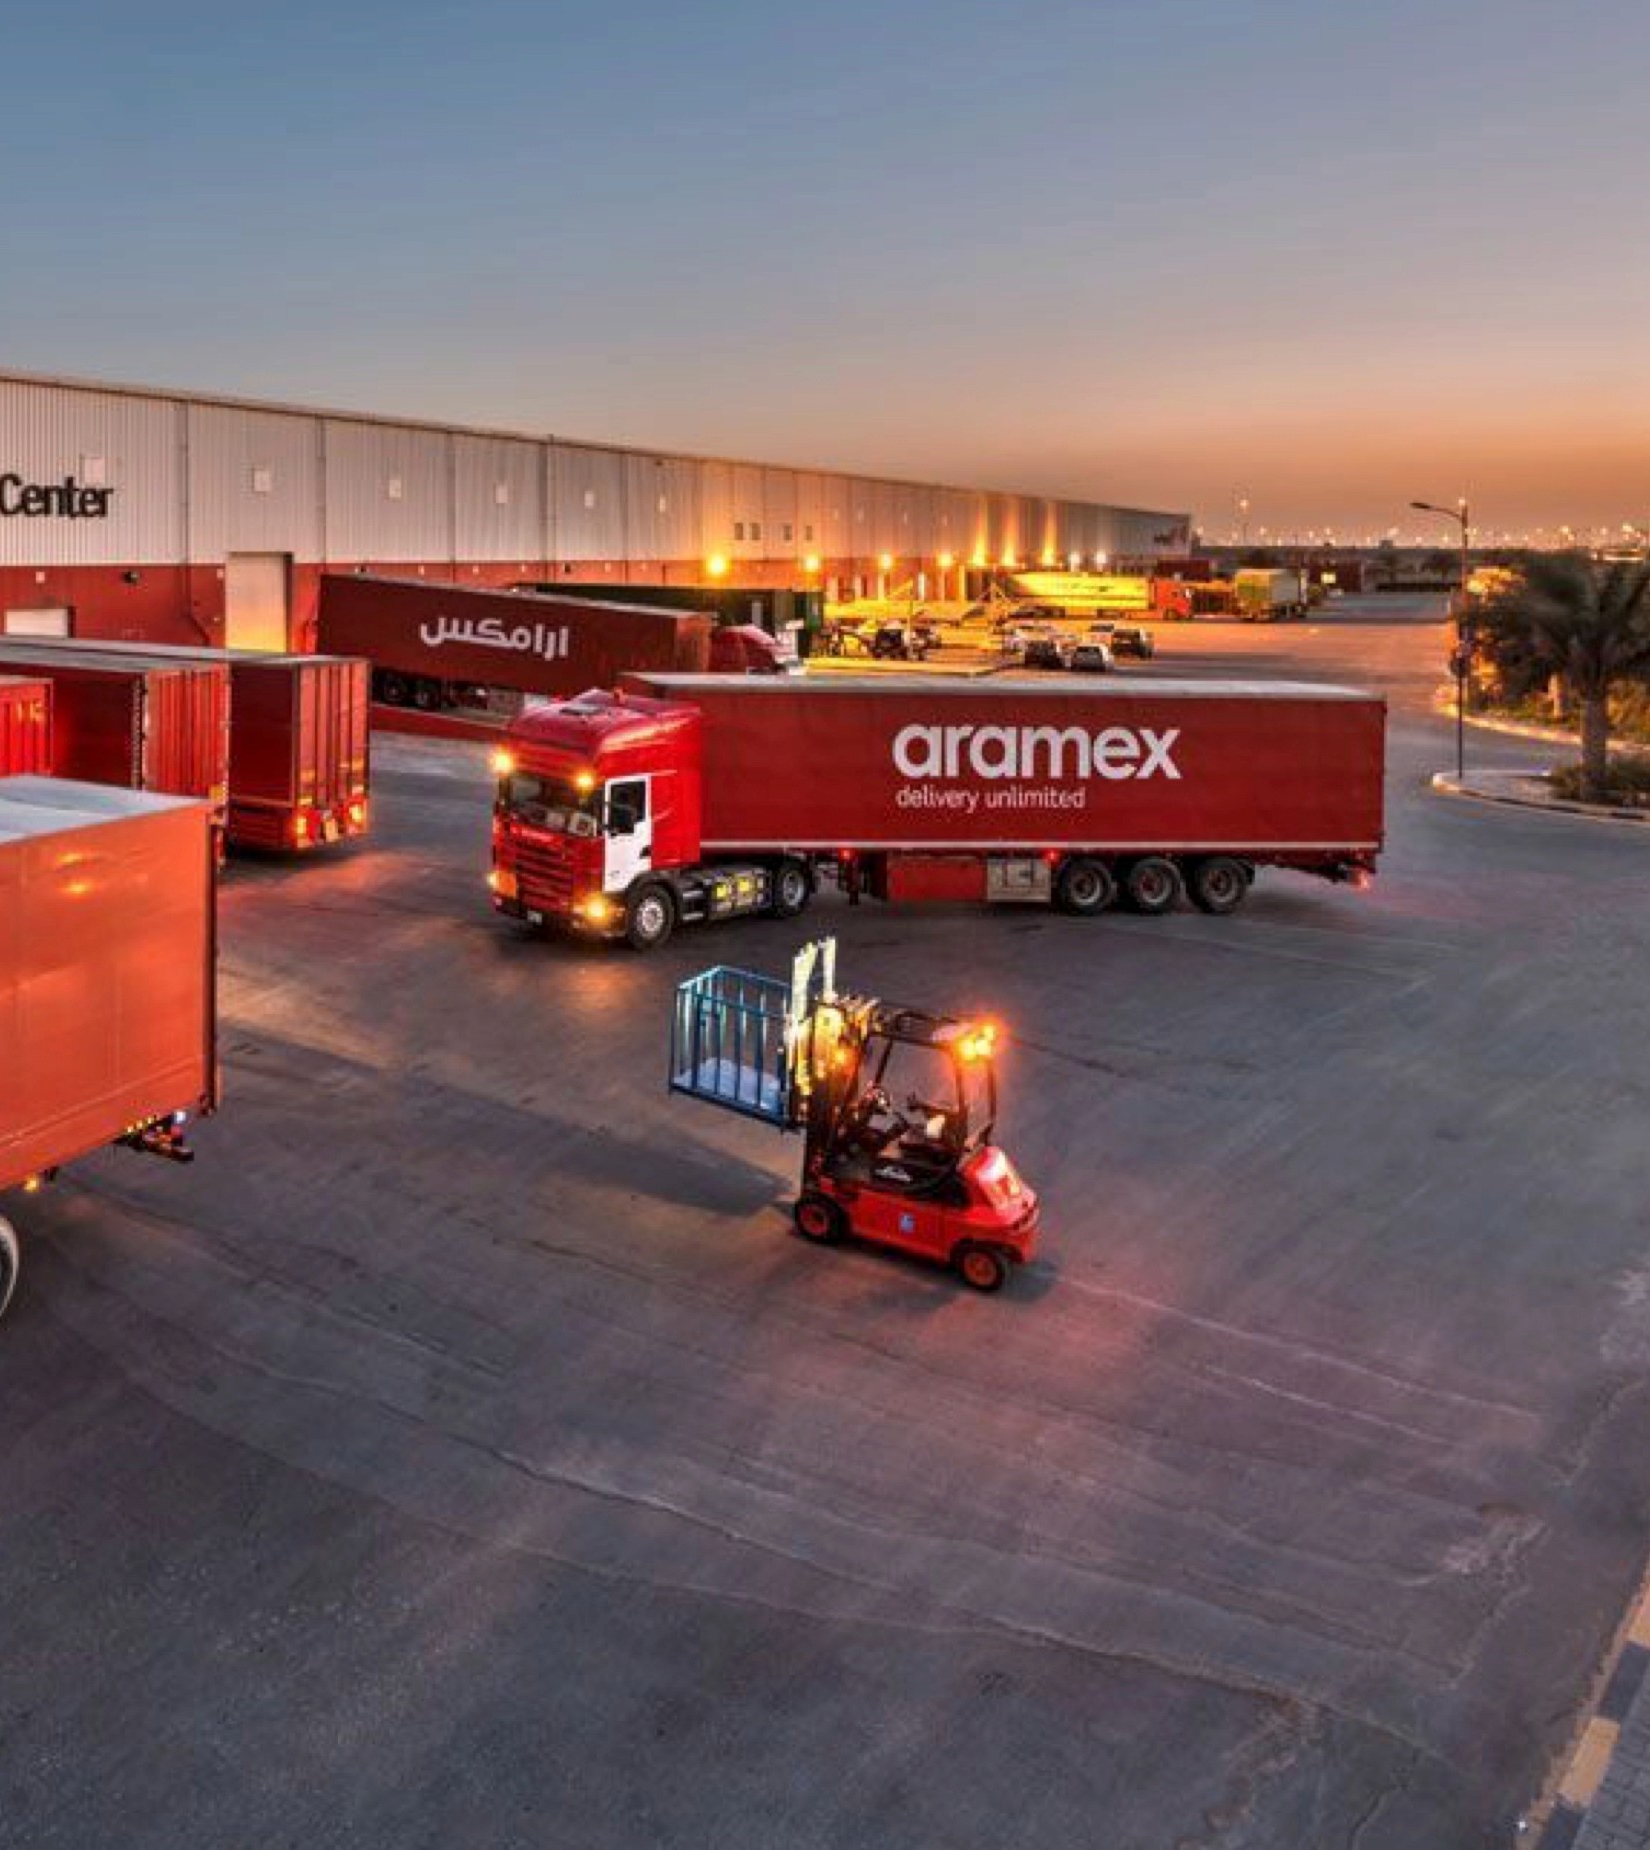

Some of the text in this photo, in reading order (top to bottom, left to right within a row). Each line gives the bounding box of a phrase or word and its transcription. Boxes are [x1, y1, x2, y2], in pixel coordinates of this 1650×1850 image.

[420, 616, 570, 662] ارامكس
[892, 723, 1182, 779] aramex
[896, 784, 1086, 813] delivery unlimited
